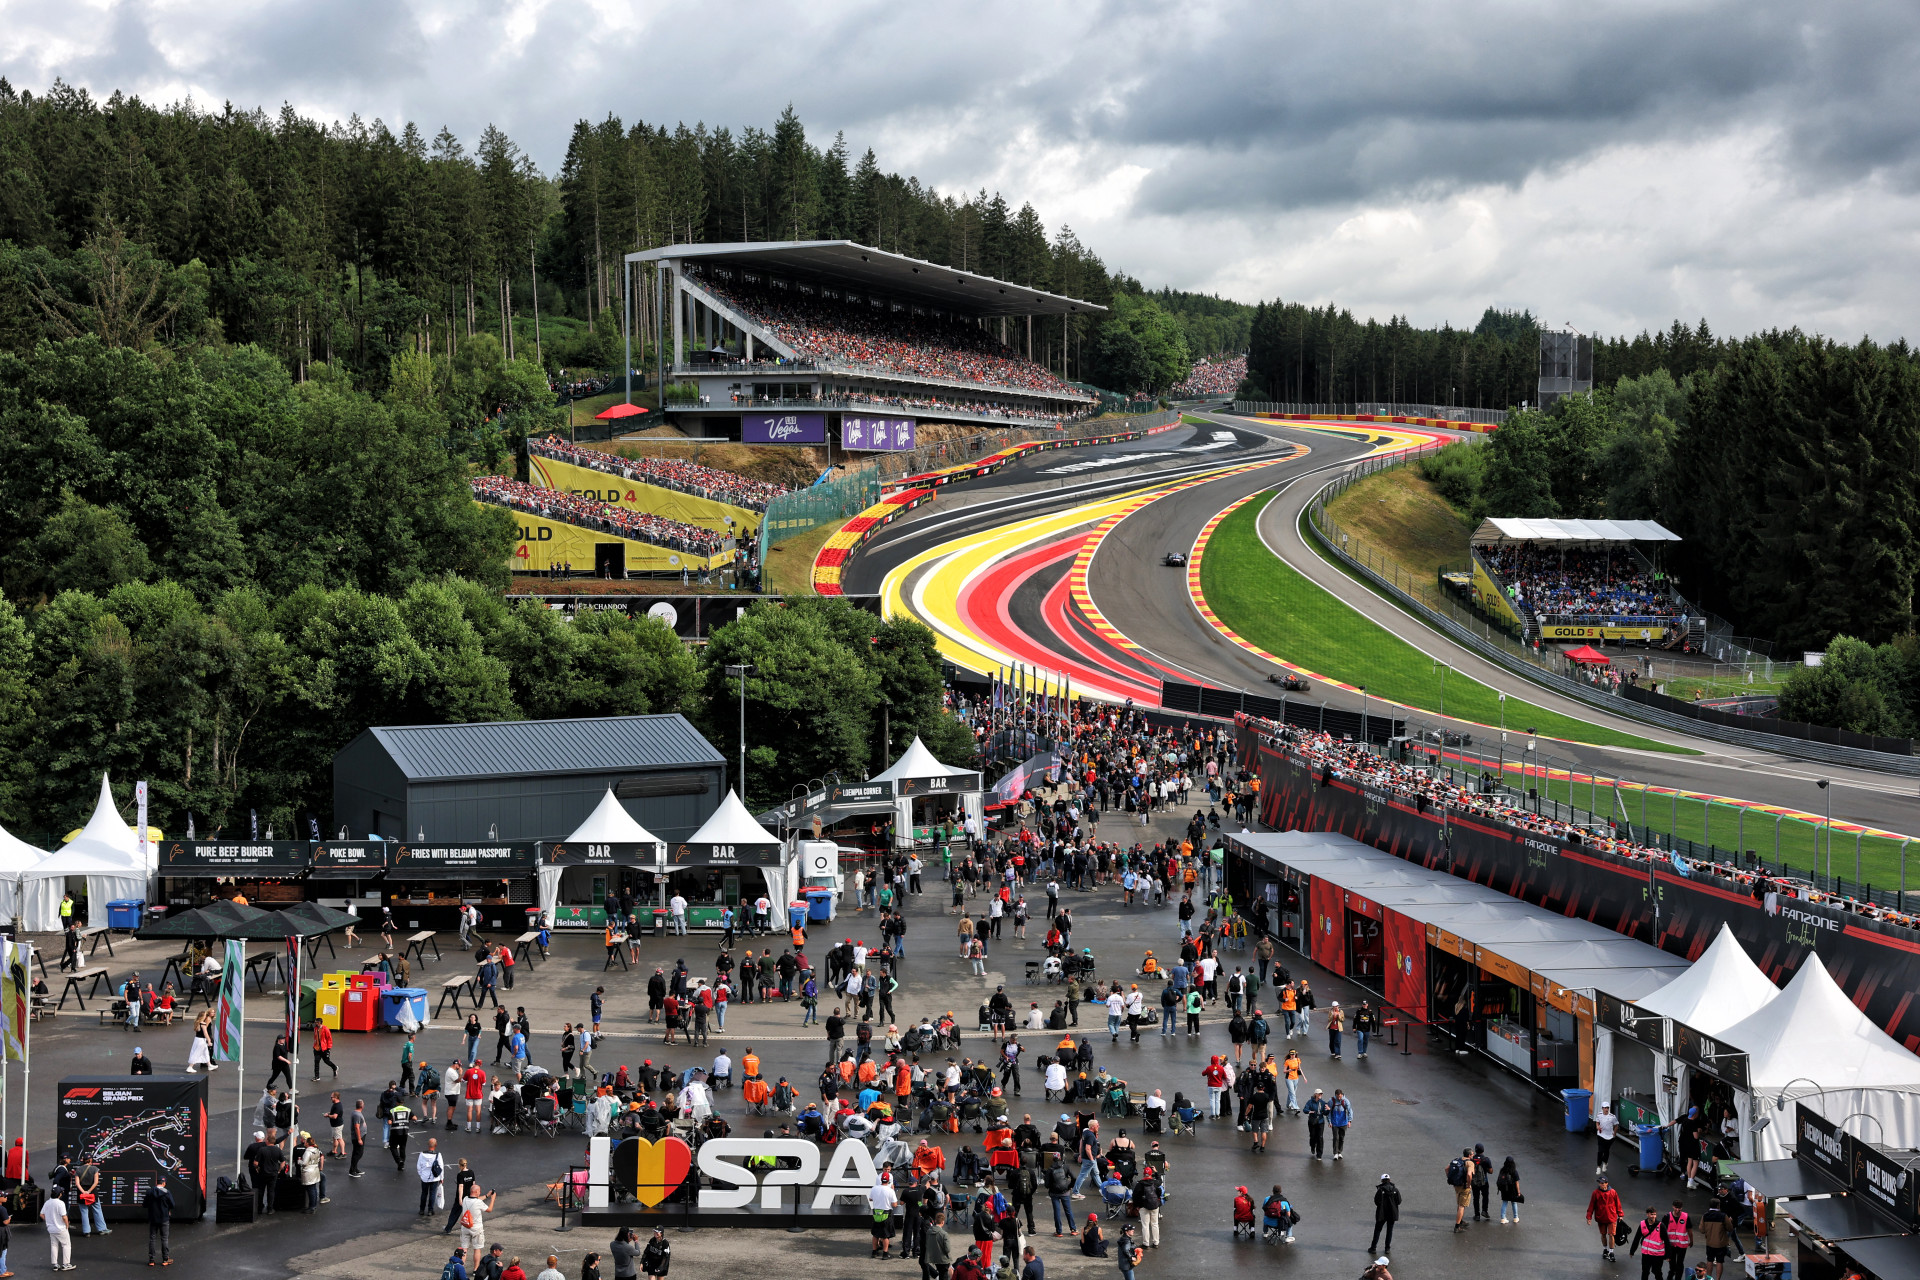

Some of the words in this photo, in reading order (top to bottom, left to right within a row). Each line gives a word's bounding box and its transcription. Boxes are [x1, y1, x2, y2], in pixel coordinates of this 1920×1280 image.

[764, 418, 803, 440] Vegas
[624, 490, 637, 503] 4
[517, 527, 553, 541] OLD
[515, 545, 530, 560] 4
[1555, 628, 1585, 637] GOLD
[1587, 628, 1594, 637] 5
[930, 777, 947, 788] BAR
[863, 787, 882, 796] CORNER
[1363, 790, 1386, 806] FANZONE
[195, 846, 217, 858] PURE
[218, 846, 239, 858] BEEF
[241, 846, 274, 858] BURGER
[329, 848, 347, 858] POKE
[348, 848, 366, 858] BOWL
[411, 849, 430, 859] FRIES
[431, 849, 448, 858] WITH
[449, 848, 476, 858] BELGIAN
[478, 848, 511, 858] PASSPORT
[588, 845, 611, 857] BAR
[712, 845, 735, 858] BAR
[1524, 838, 1558, 856] FANZONE
[1642, 887, 1648, 901] F
[1658, 886, 1664, 900] E
[1781, 906, 1839, 932] FANZONE
[63, 1088, 102, 1098] F1
[589, 1136, 611, 1208] I
[697, 1138, 879, 1209] SPA
[1866, 1160, 1880, 1186] MEAT
[1881, 1169, 1897, 1197] BUNS
